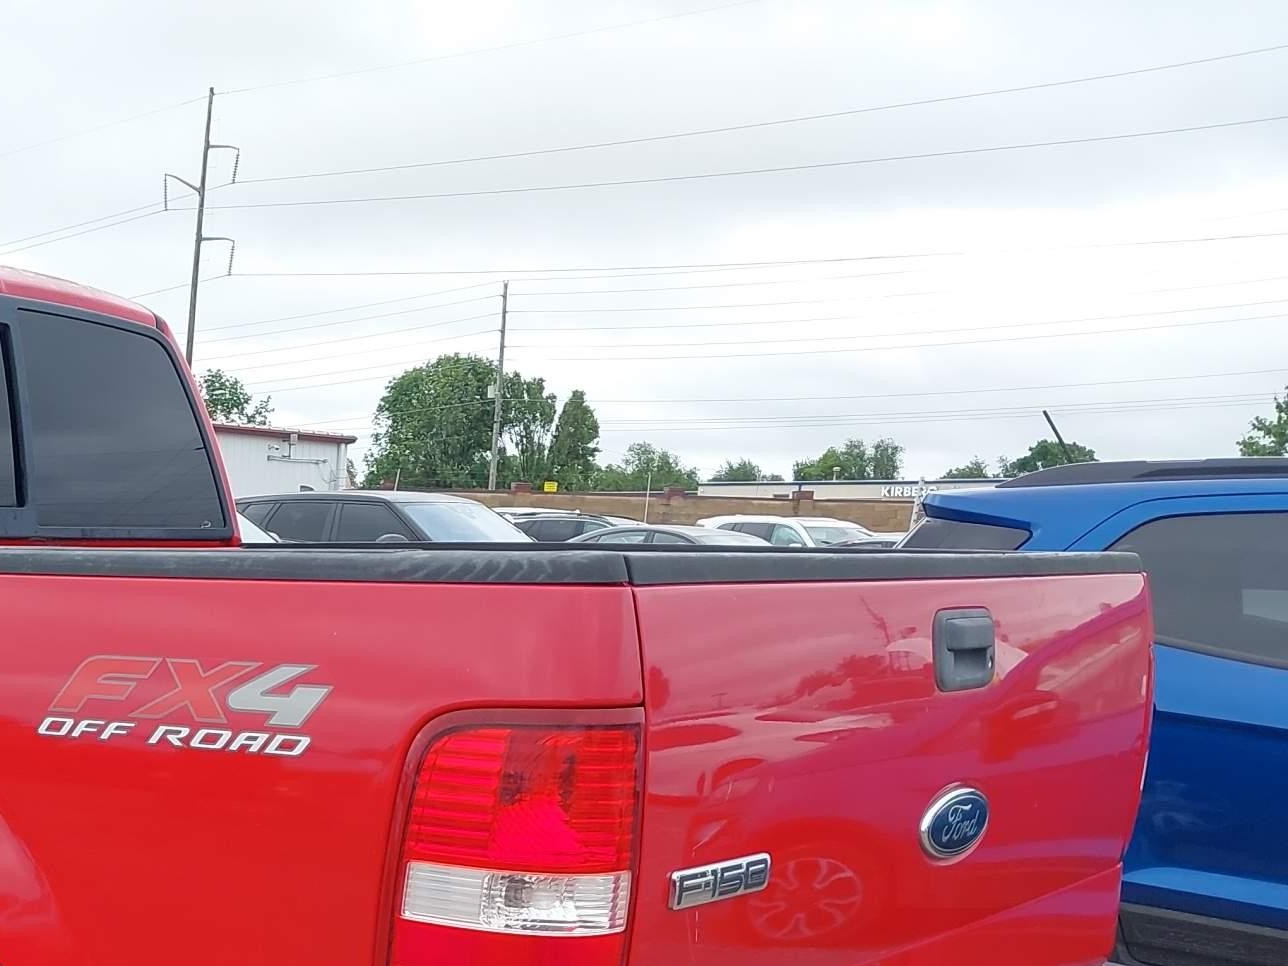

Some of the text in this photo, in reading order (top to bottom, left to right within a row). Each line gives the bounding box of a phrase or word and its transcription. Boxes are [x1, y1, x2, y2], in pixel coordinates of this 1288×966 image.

[48, 655, 335, 728] FX4
[38, 717, 312, 757] OFF ROAD
[941, 803, 980, 843] Ford
